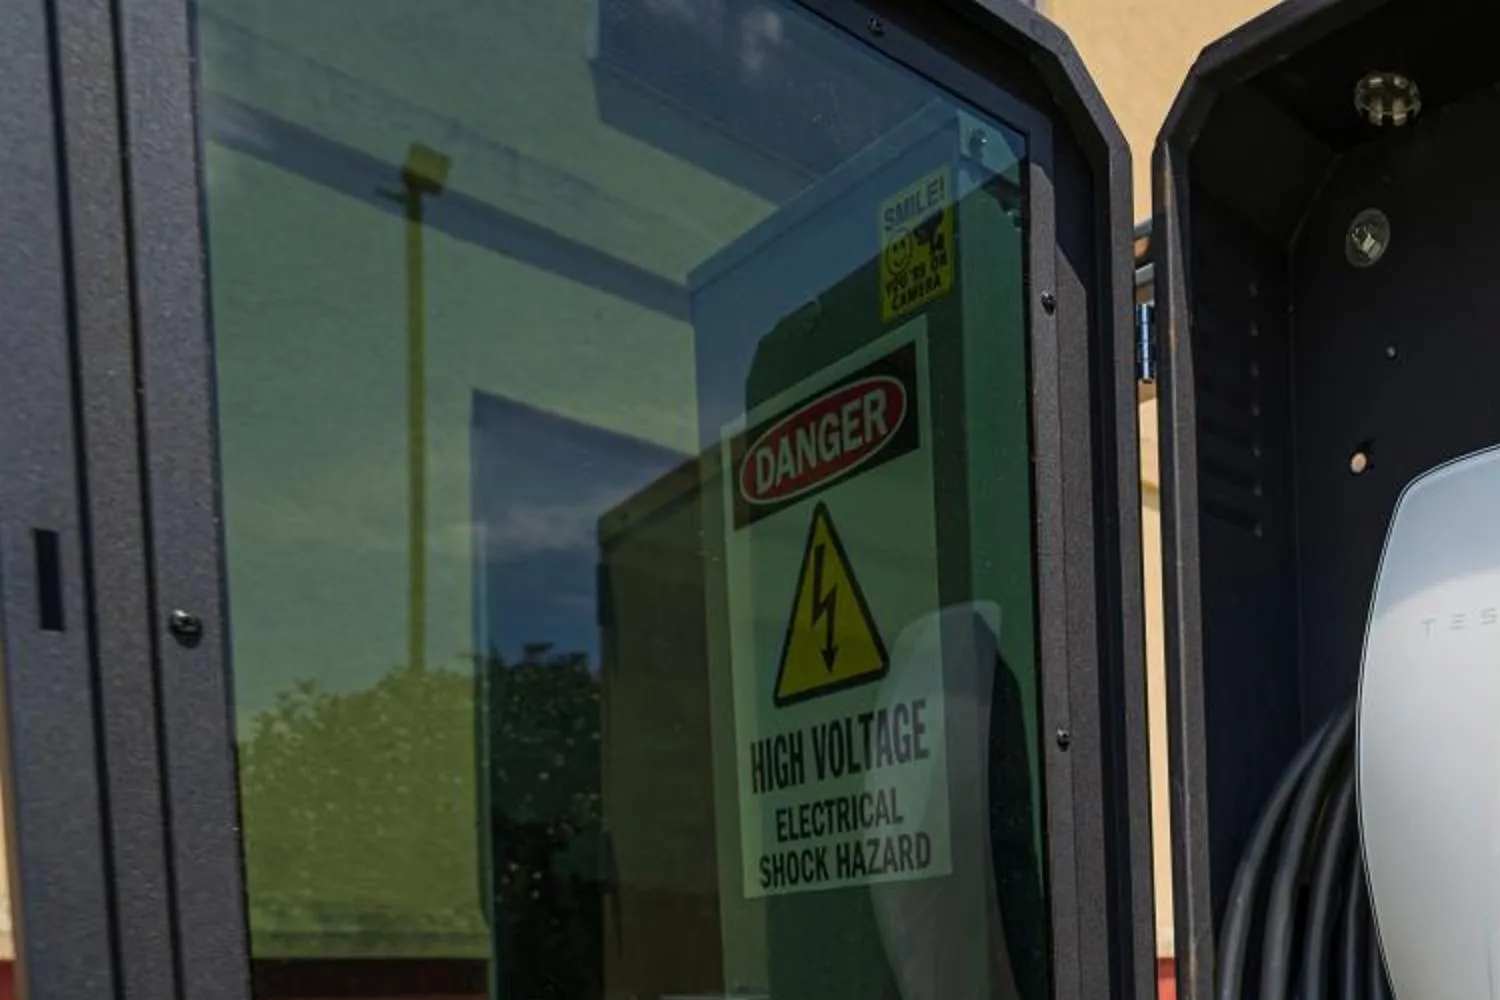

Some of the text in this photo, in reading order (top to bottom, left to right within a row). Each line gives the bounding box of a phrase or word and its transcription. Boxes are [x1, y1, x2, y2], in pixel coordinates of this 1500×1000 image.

[884, 174, 945, 231] SMILE!
[754, 387, 889, 495] DANGER
[750, 700, 930, 795] HIGH VOLTAGE
[775, 786, 905, 843] ELECTRICAL
[758, 830, 932, 890] SHOCK HAZARD
